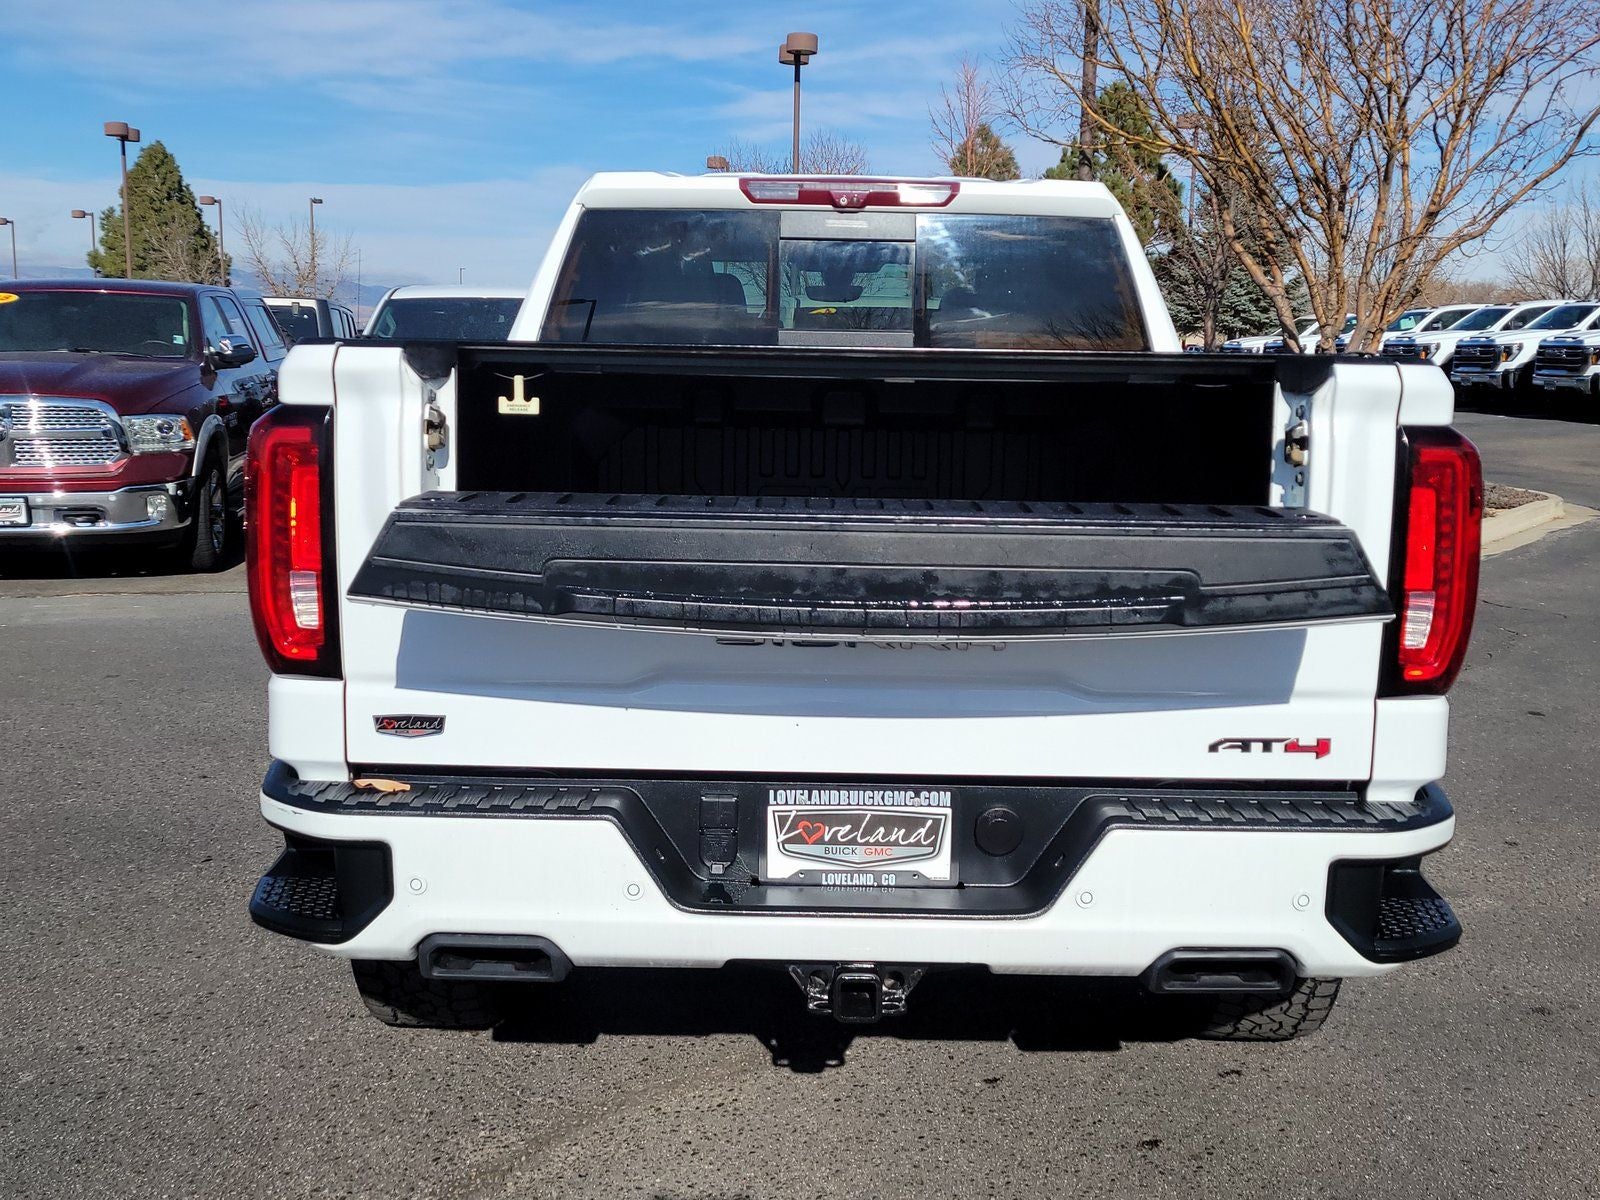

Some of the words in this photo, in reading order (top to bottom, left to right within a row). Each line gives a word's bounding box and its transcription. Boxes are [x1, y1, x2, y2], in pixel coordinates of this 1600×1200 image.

[376, 715, 442, 729] Loveland
[1208, 737, 1331, 760] AT4
[769, 789, 952, 807] LOVELANDBUICKGMC.COM
[776, 809, 936, 845] Loveland
[824, 846, 858, 856] BUICK
[864, 847, 893, 857] GMC
[822, 872, 878, 887] LOVELAND,
[881, 873, 897, 886] CO
